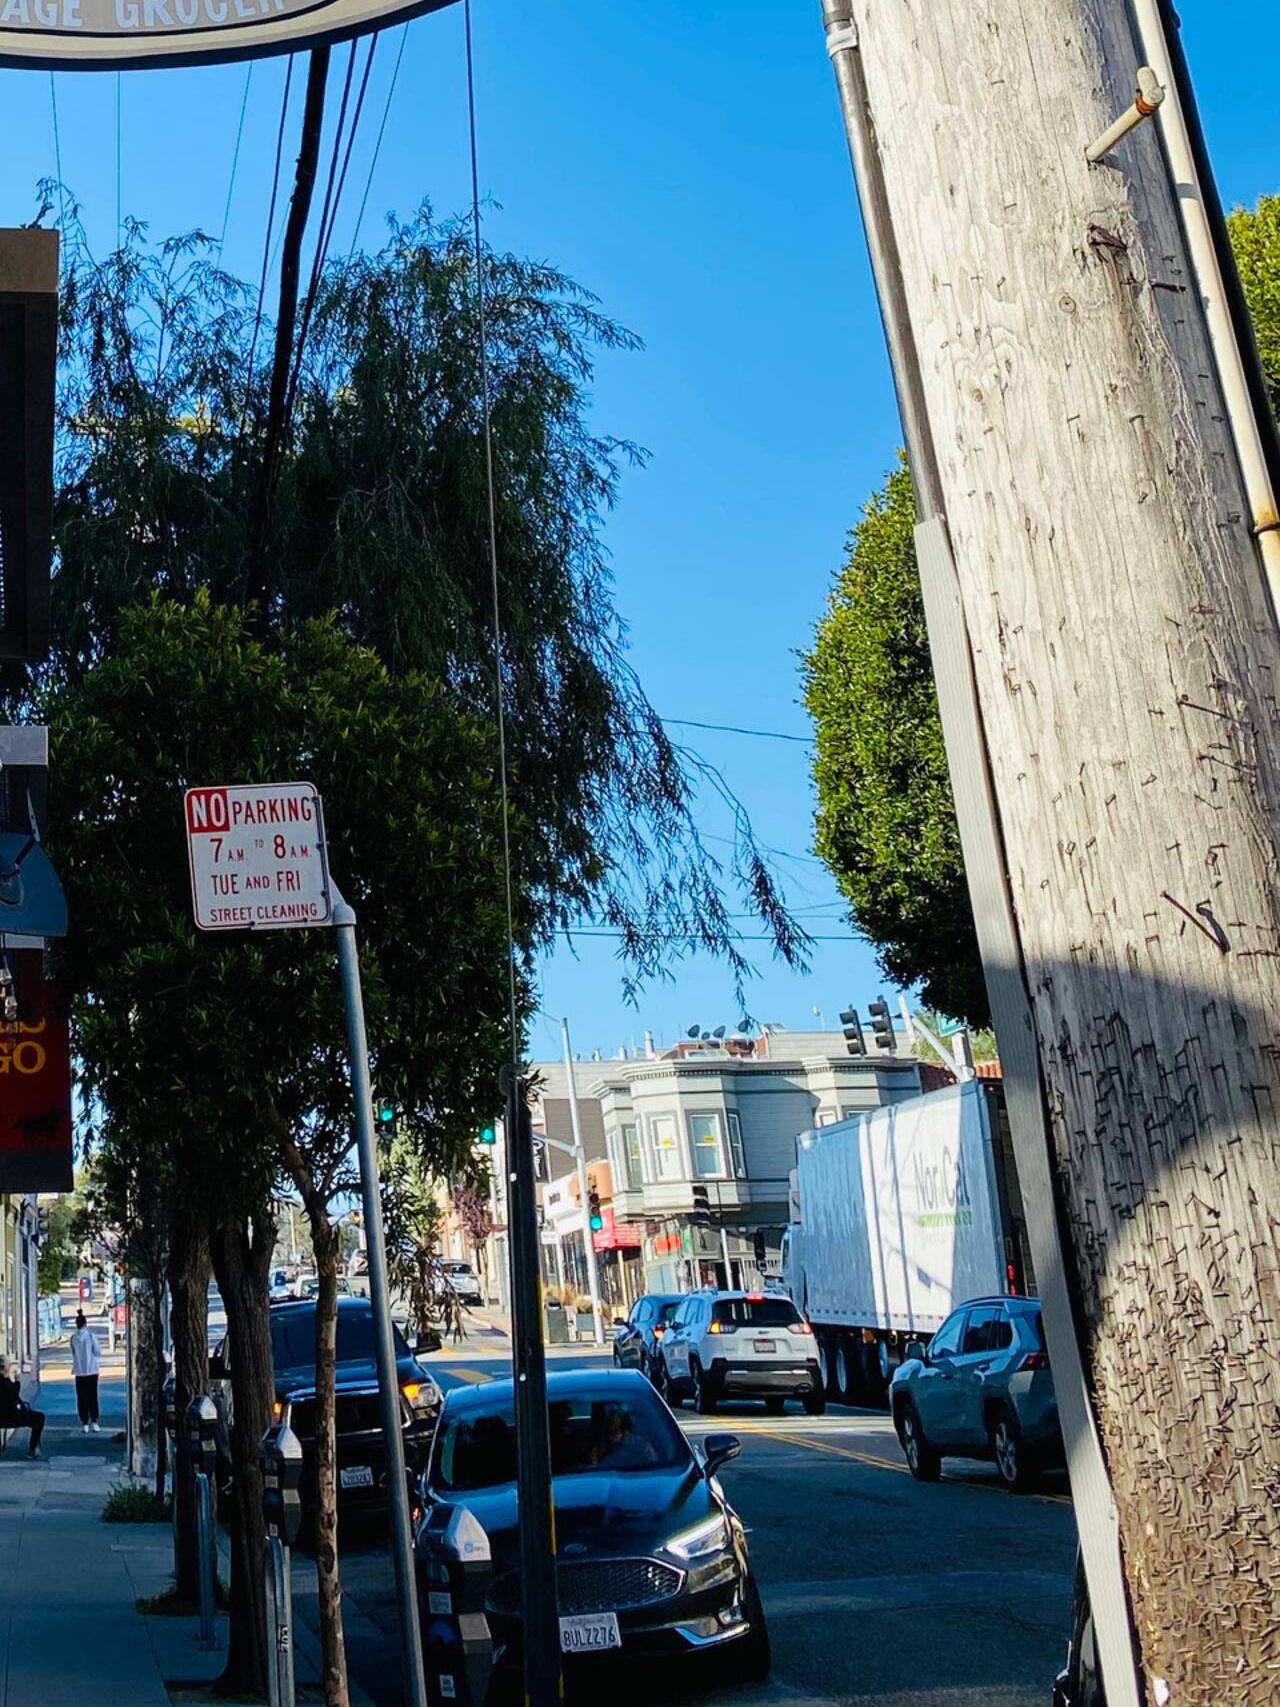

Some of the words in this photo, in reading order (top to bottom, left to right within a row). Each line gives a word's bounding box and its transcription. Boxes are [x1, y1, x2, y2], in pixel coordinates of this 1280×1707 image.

[190, 793, 226, 828] NO
[232, 796, 312, 825] PARKING
[209, 837, 224, 863] 7
[254, 839, 265, 849] TO
[273, 834, 287, 860] 8
[290, 845, 312, 858] A.M.
[210, 873, 240, 896] TUE
[245, 875, 270, 890] AND
[276, 870, 301, 893] FRI
[210, 906, 253, 923] STREET
[256, 903, 318, 920] CLEANING
[563, 1625, 617, 1648] 8ULZ276
